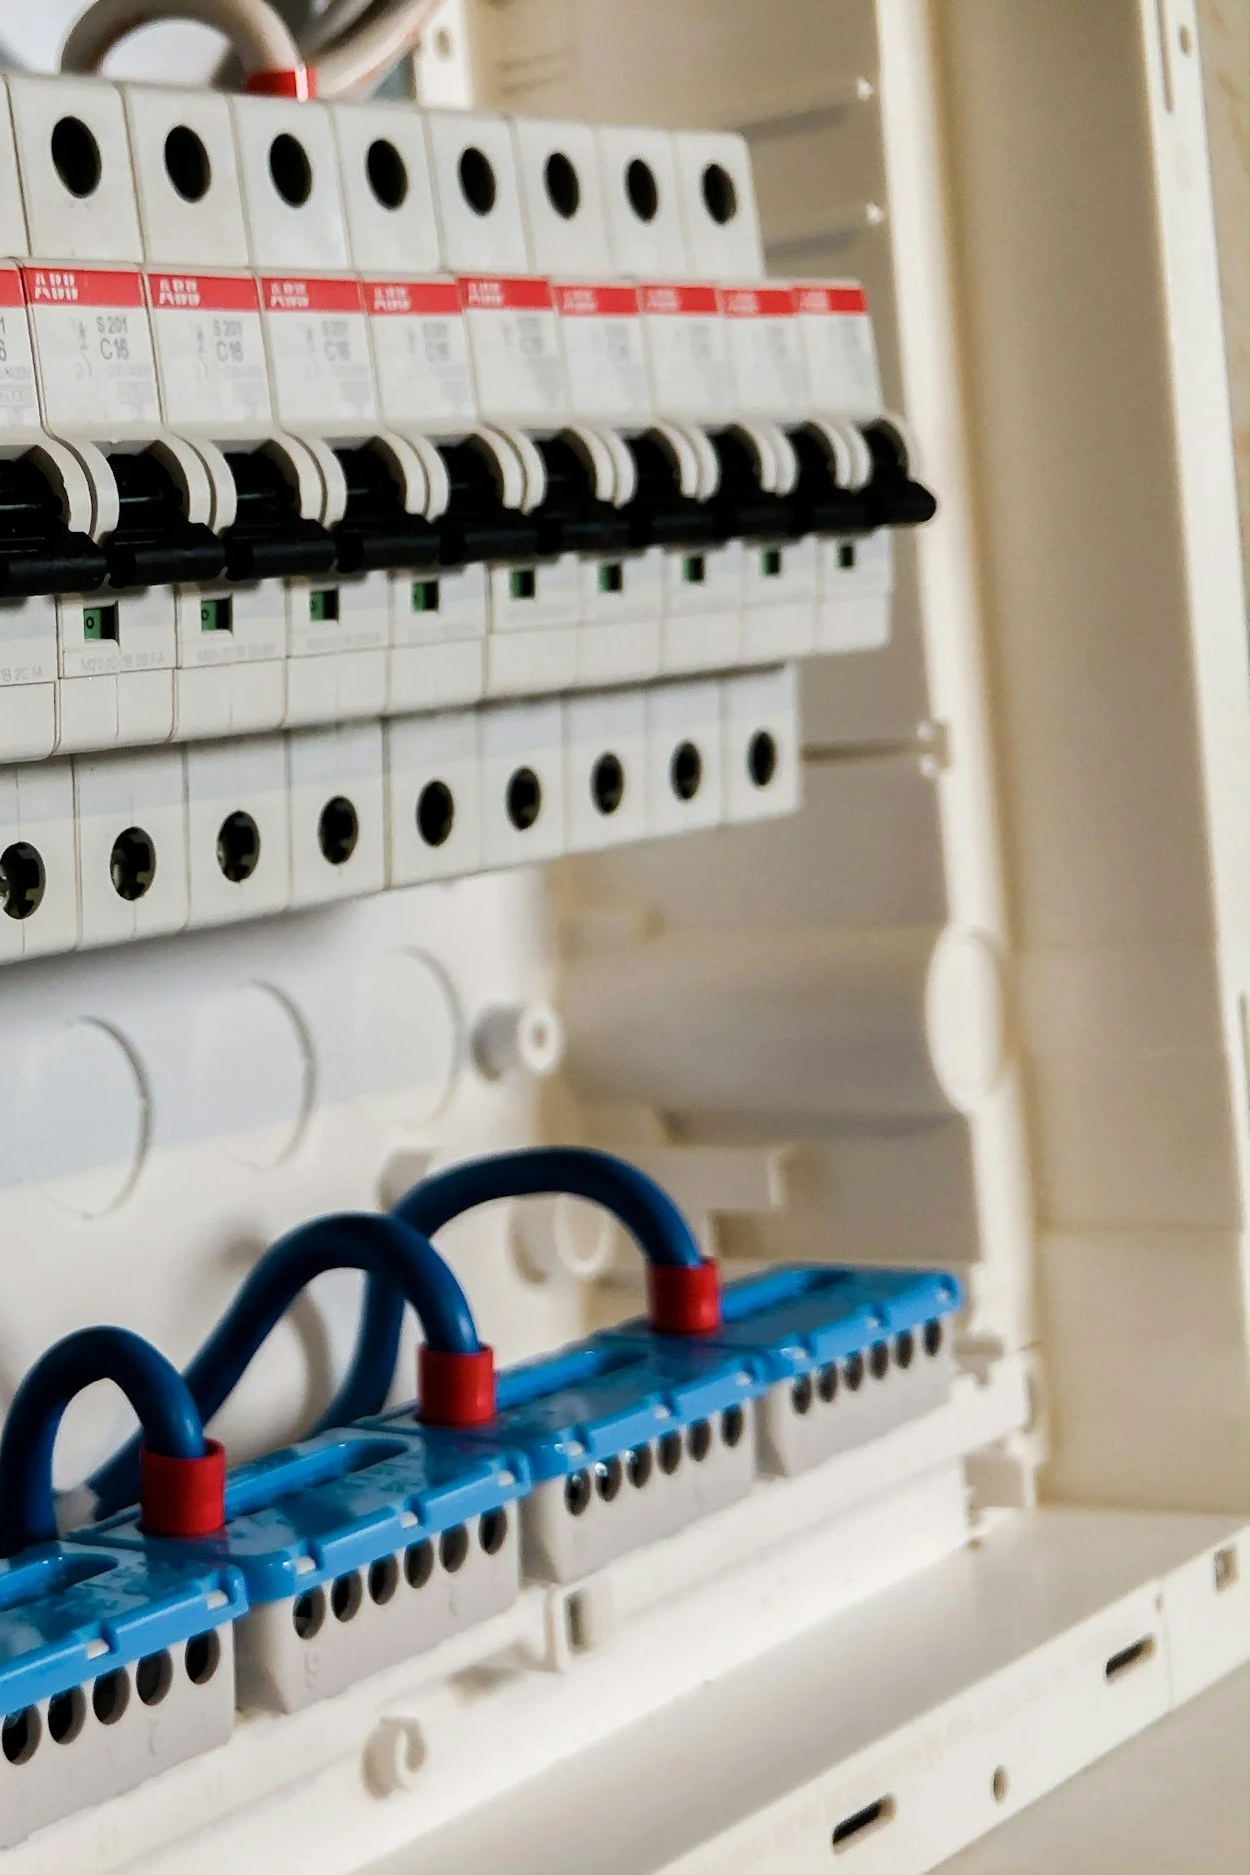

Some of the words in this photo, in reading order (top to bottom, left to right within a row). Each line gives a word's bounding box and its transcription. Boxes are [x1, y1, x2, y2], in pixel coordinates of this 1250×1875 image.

[34, 272, 79, 301] ABB
[159, 278, 201, 306] ABB
[270, 282, 310, 308] ABB
